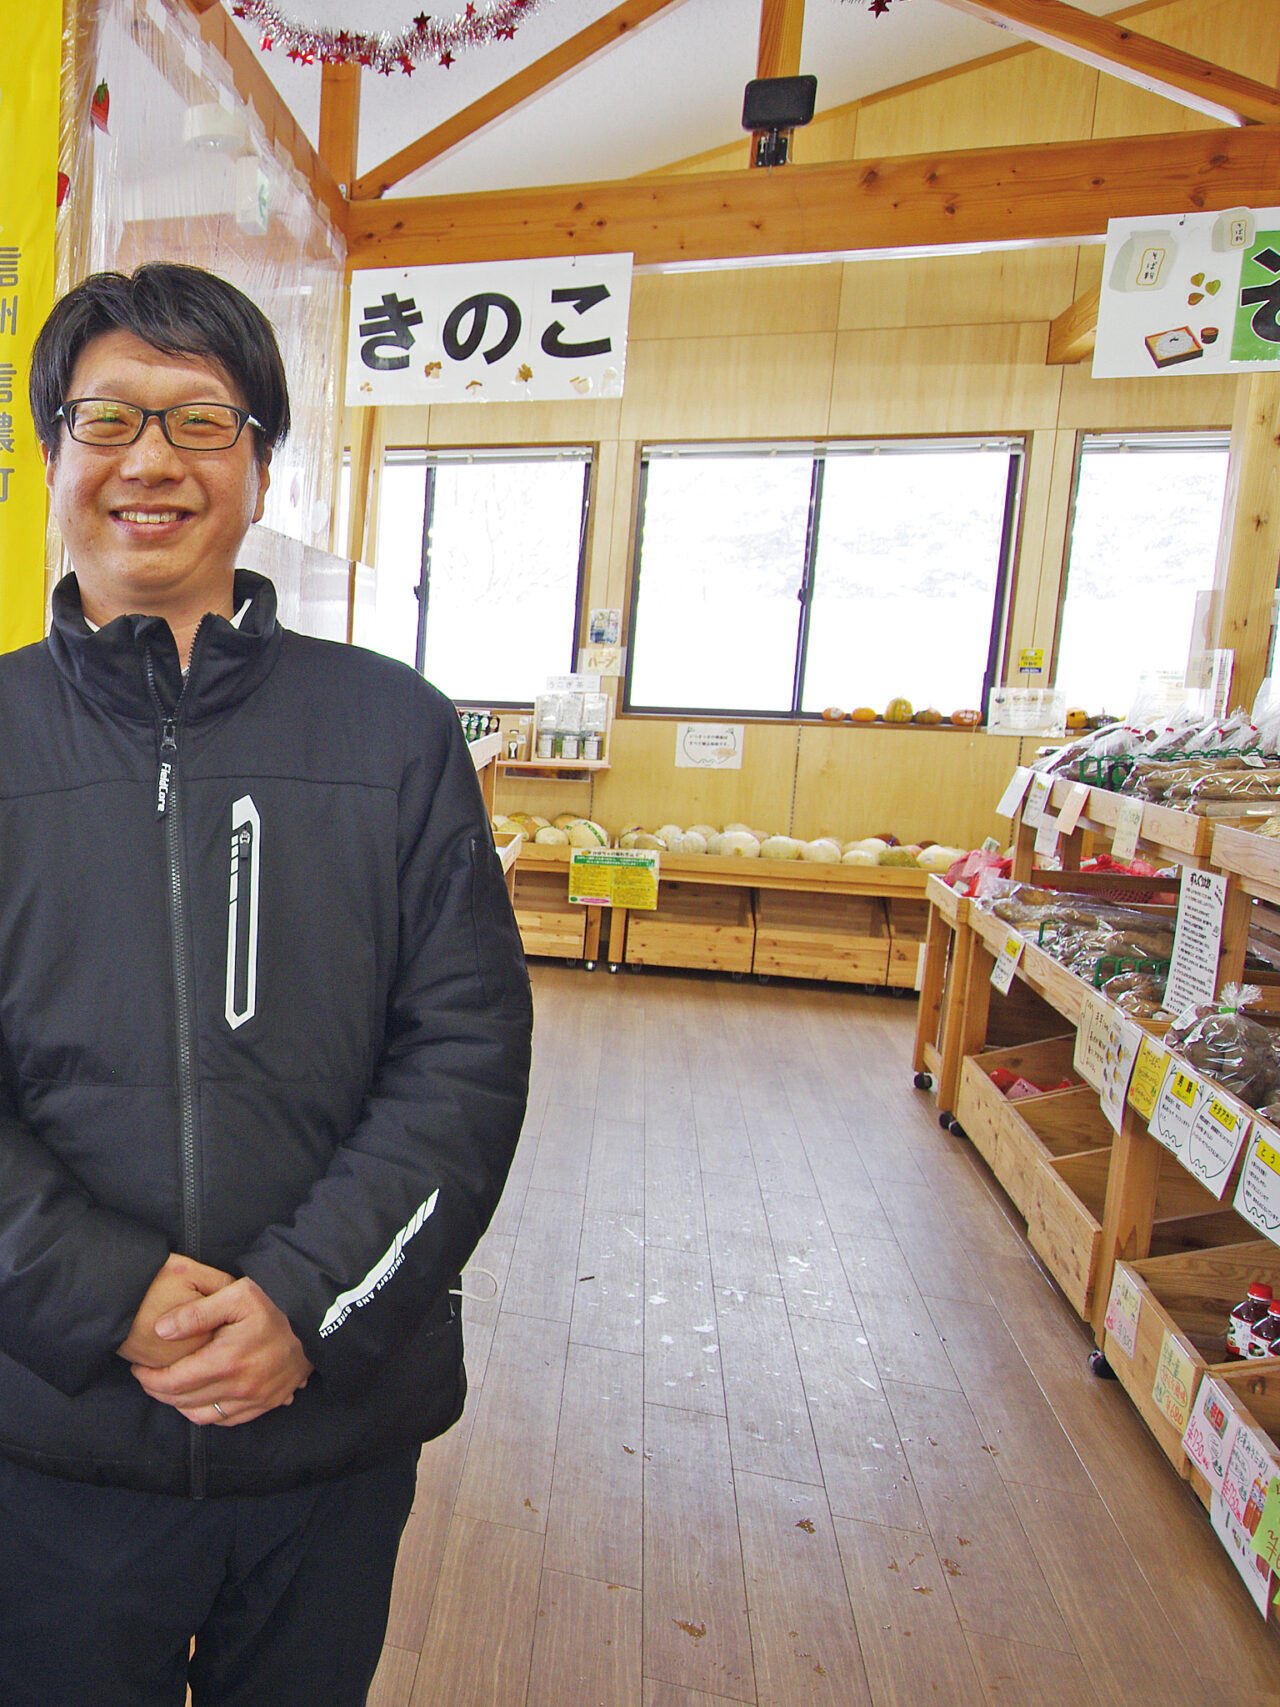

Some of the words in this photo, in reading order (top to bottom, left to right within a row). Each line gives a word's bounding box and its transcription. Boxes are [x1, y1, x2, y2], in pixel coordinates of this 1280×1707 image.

[357, 284, 612, 372] きのこ
[156, 761, 172, 813] FieldCore
[355, 1291, 376, 1310] AND
